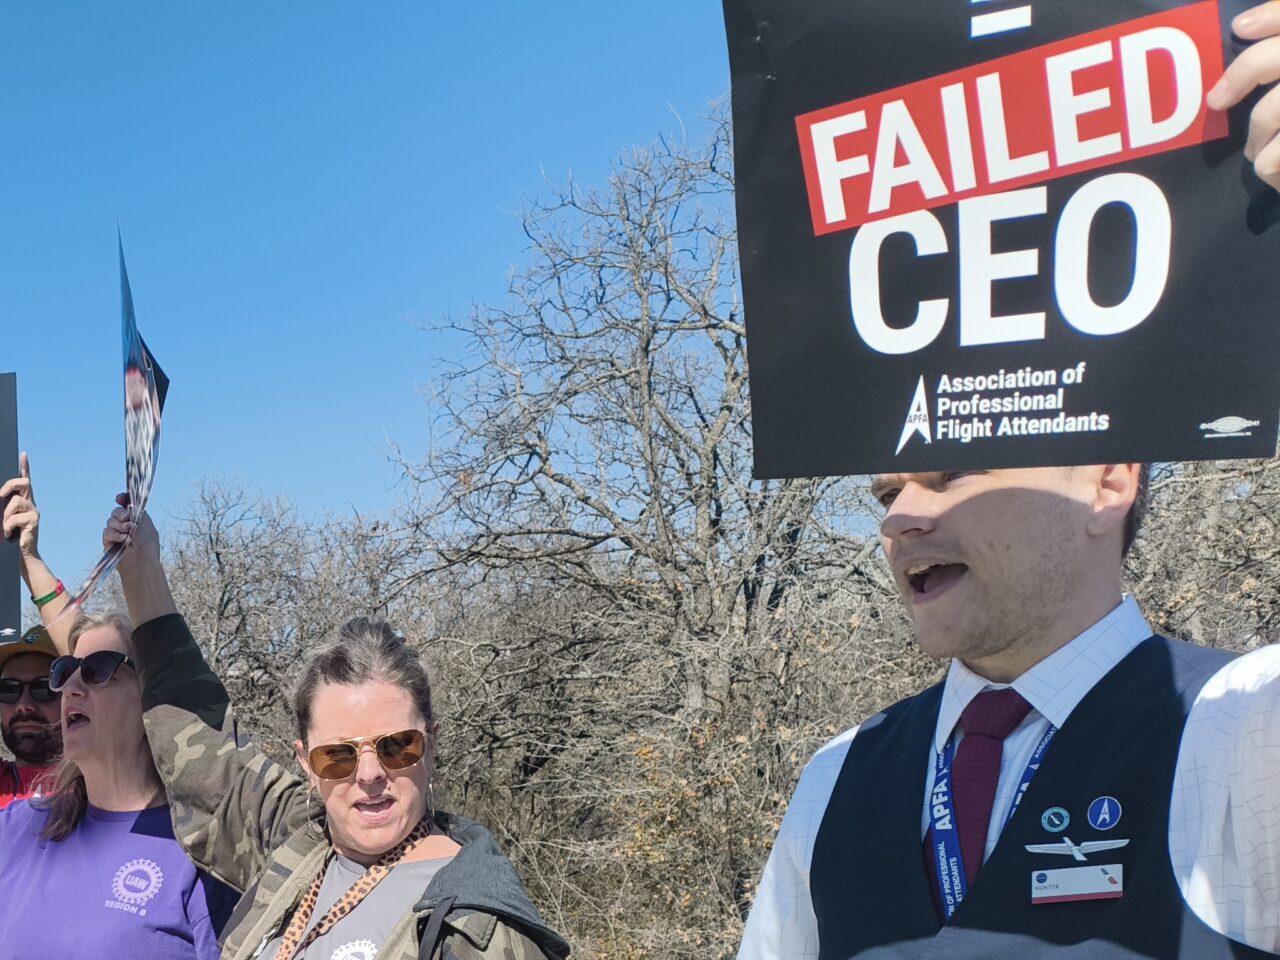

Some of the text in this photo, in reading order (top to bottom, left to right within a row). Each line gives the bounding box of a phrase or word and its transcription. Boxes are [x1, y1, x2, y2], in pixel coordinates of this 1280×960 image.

[810, 26, 1203, 224] FAILED
[849, 172, 1172, 355] CEO
[937, 361, 1086, 394] Association of
[937, 388, 1064, 416] Professional
[907, 414, 928, 424] APFA
[936, 412, 1110, 443] Flight Attendants
[932, 778, 953, 830] APFA
[125, 874, 150, 890] UAW
[938, 841, 952, 894] PROFESSIONAL
[104, 900, 147, 916] REGION 8
